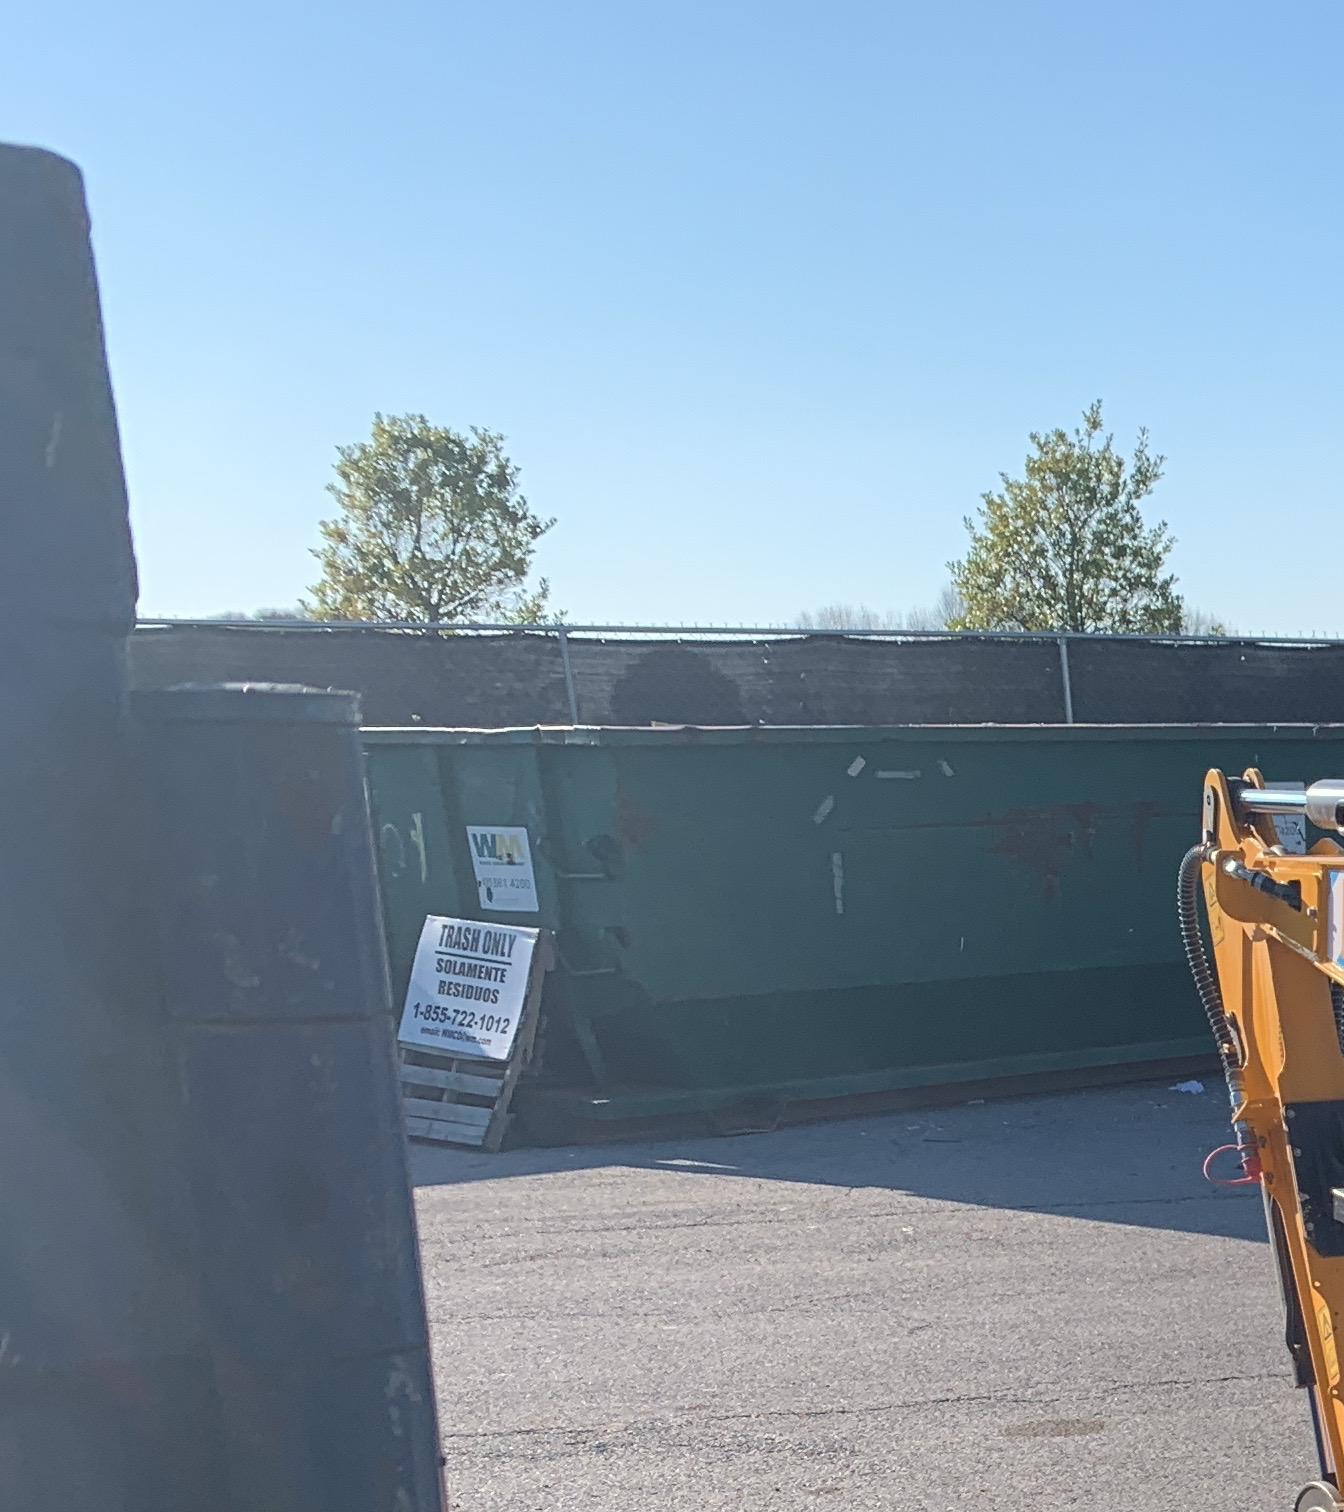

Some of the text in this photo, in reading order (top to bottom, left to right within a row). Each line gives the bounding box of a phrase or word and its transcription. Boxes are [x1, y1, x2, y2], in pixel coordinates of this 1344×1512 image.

[471, 832, 524, 860] WM
[438, 924, 517, 958] TRASH ONLY
[435, 958, 507, 983] SOLAMENTE
[438, 980, 500, 1004] RESIDUOS
[413, 1002, 510, 1035] 1-855-722-1012
